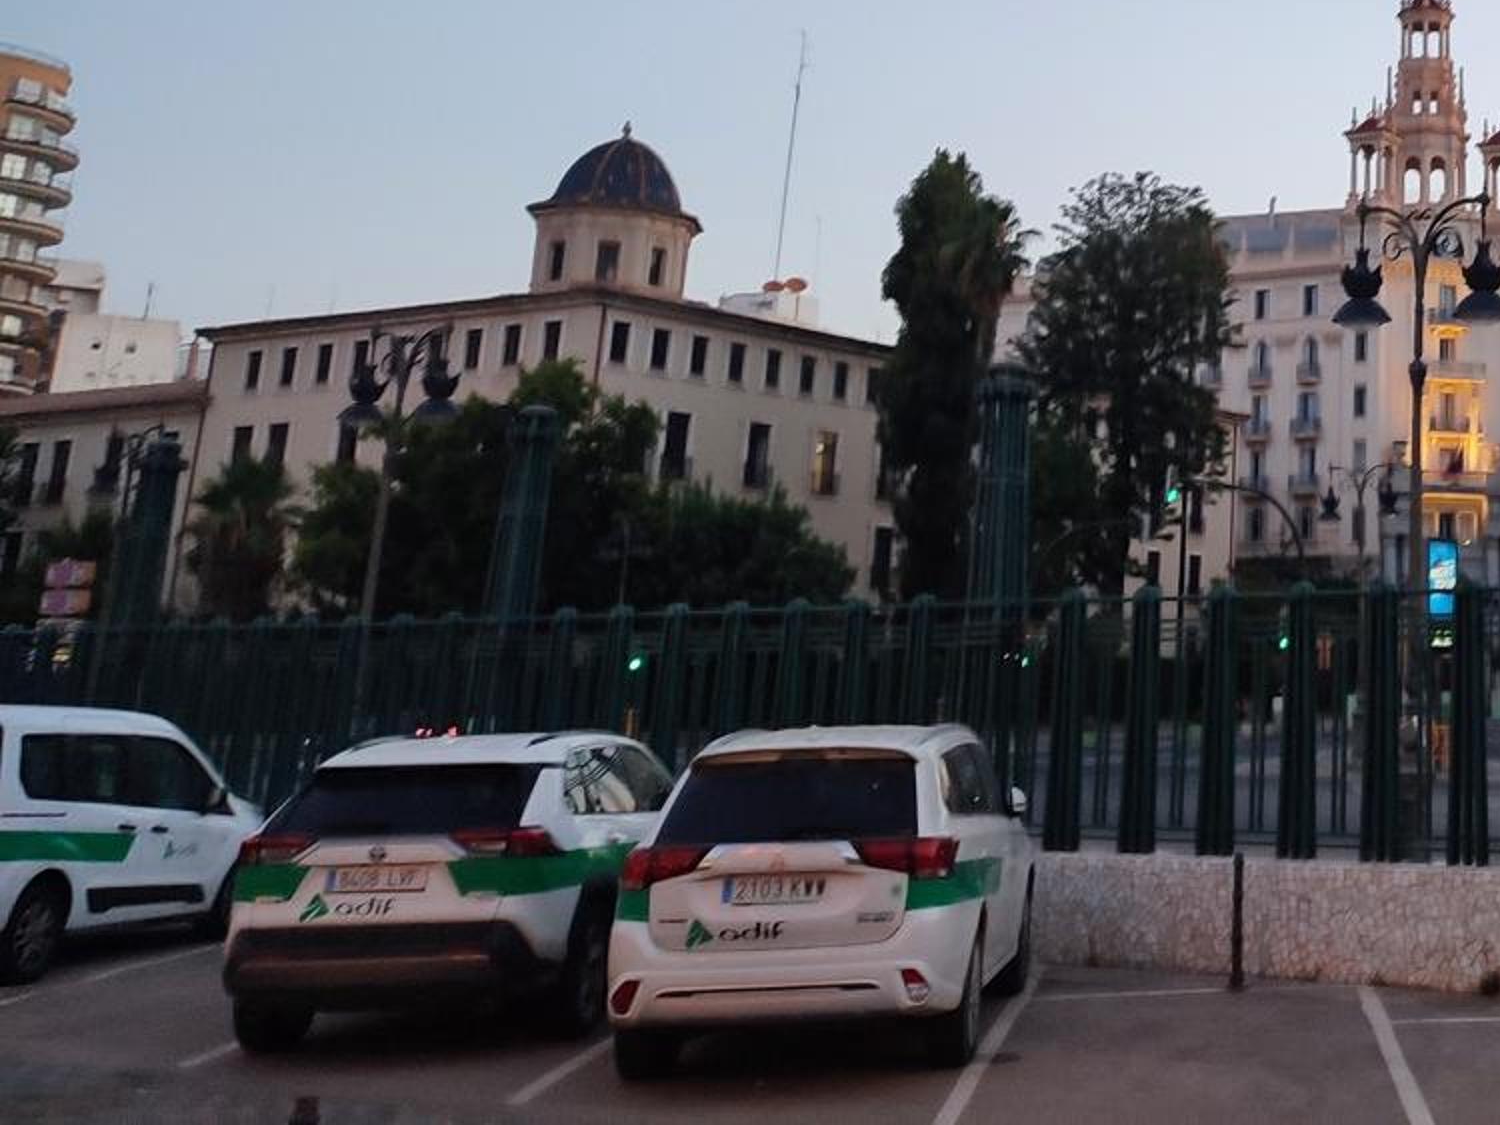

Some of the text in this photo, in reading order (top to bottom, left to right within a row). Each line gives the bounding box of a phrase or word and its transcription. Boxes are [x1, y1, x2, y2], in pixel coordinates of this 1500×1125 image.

[735, 877, 784, 899] 2103
[335, 897, 394, 915] adif
[719, 920, 785, 941] adif
